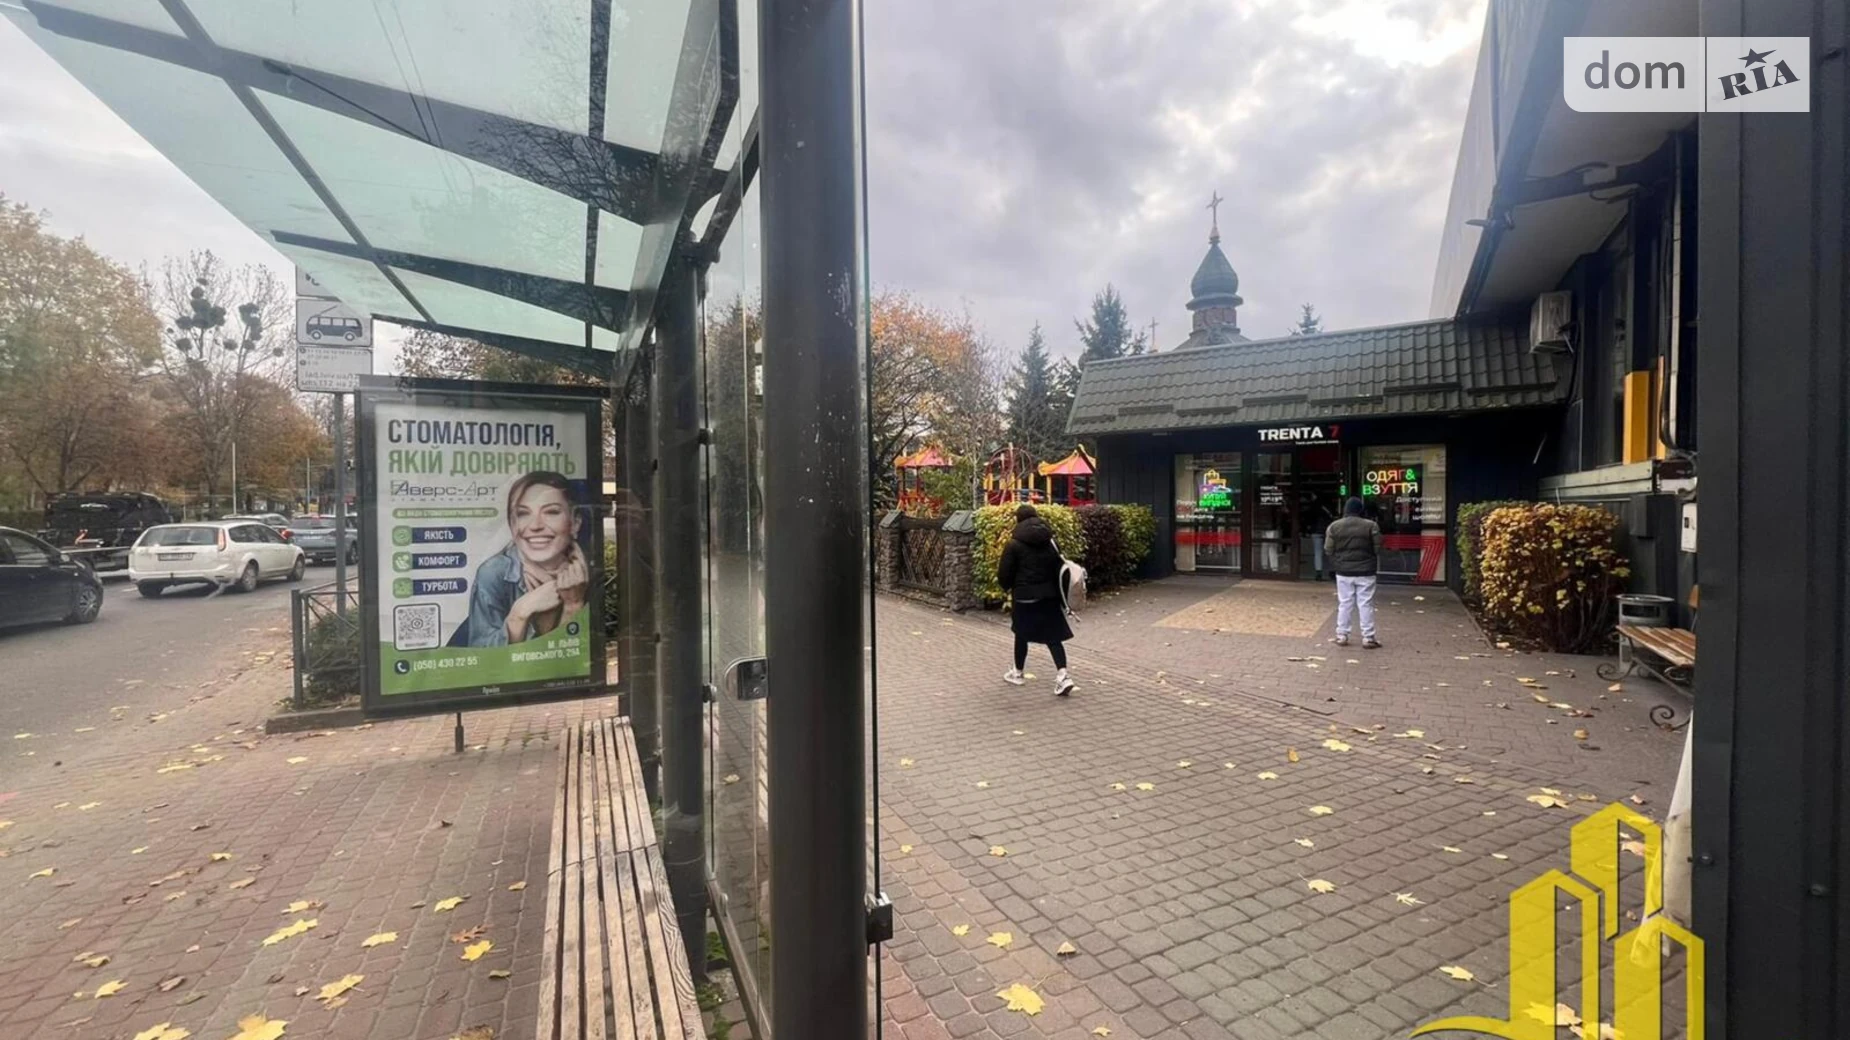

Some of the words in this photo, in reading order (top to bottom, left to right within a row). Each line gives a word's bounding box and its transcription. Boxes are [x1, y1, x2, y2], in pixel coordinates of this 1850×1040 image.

[388, 419, 561, 450] СТОМАТОЛОГІЯ,
[1258, 426, 1324, 442] TRENTA
[1329, 425, 1340, 439] 7
[388, 445, 443, 475] ЯКІЙ
[450, 450, 576, 477] ДОВІРЯЮТЬ
[1362, 482, 1419, 496] ВЗУТТЯ
[424, 530, 454, 540] ЯКІСТЬ
[418, 556, 460, 566] КОМФОРТ
[422, 581, 459, 592] ТУРБОТА
[413, 660, 437, 671] (050)
[438, 658, 454, 668] 430
[455, 657, 466, 667] 22
[467, 656, 478, 666] 55
